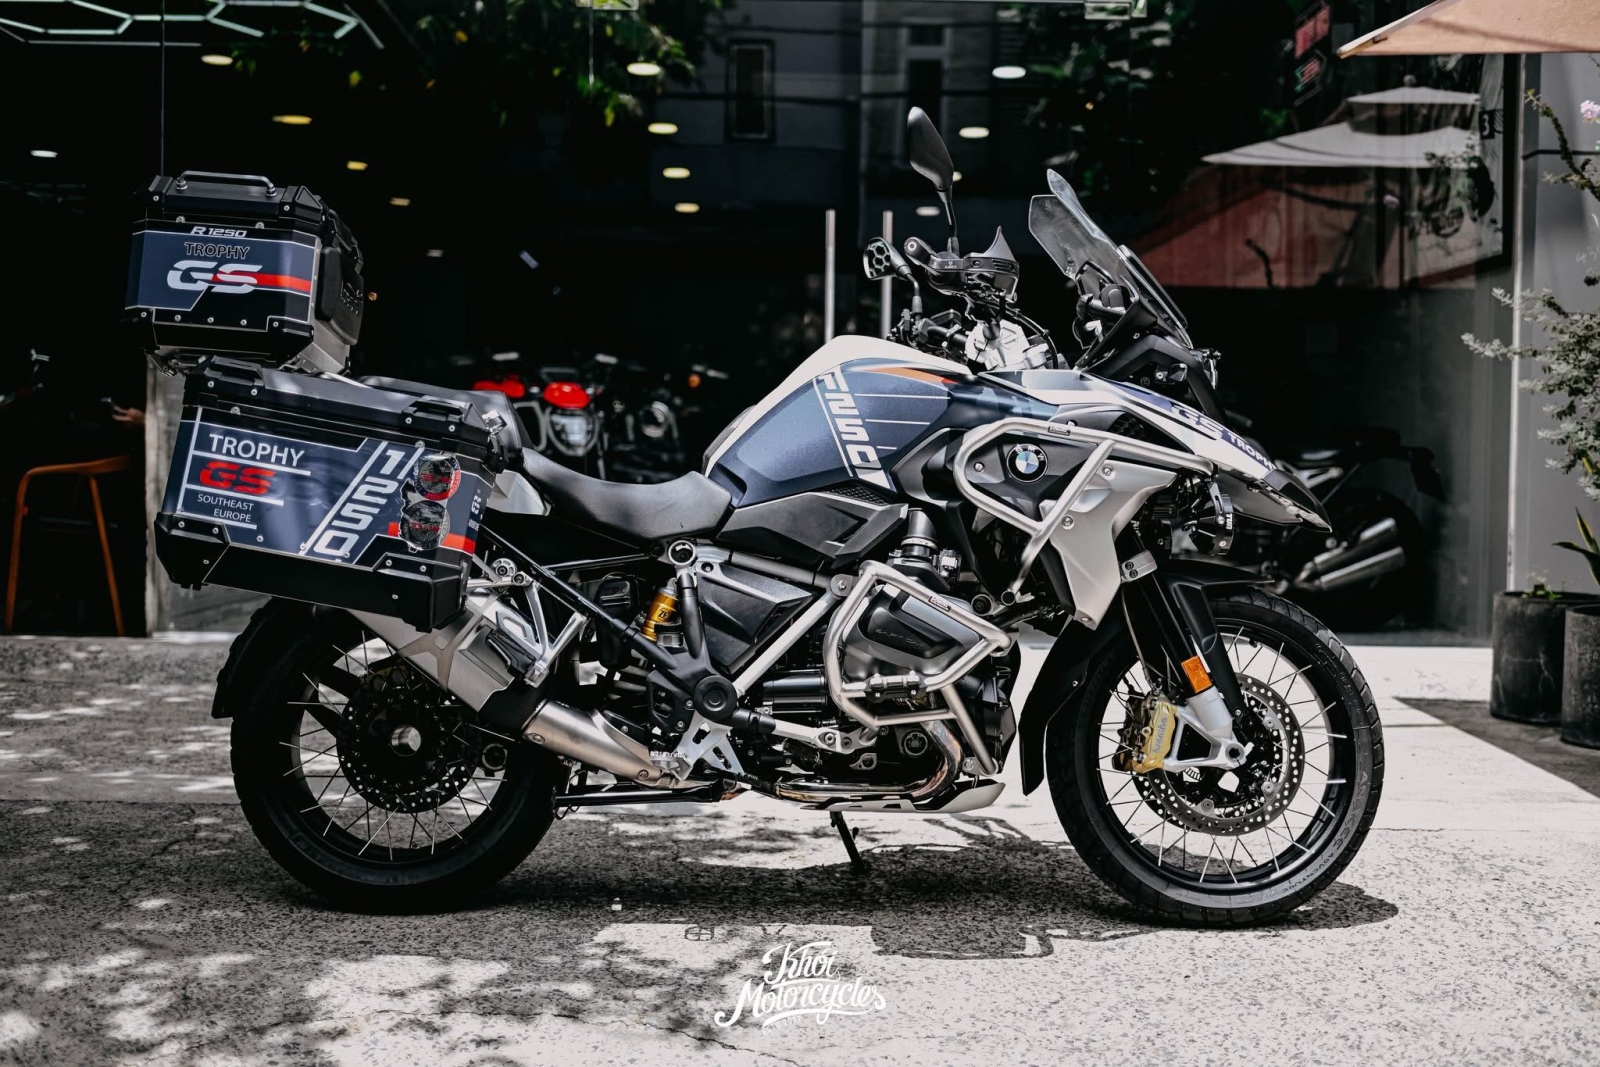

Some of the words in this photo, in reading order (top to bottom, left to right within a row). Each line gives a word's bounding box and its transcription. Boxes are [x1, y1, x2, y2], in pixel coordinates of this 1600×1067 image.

[208, 228, 247, 238] 1250
[184, 241, 250, 260] TROPHY
[167, 260, 263, 294] GS
[209, 433, 305, 467] TROPHY
[1014, 443, 1046, 462] BMW
[199, 460, 277, 496] GS
[197, 493, 255, 512] SOUTHEAST
[213, 508, 252, 523] EUROPE
[313, 448, 406, 558] 1250
[1282, 852, 1334, 894] ADVENTURE
